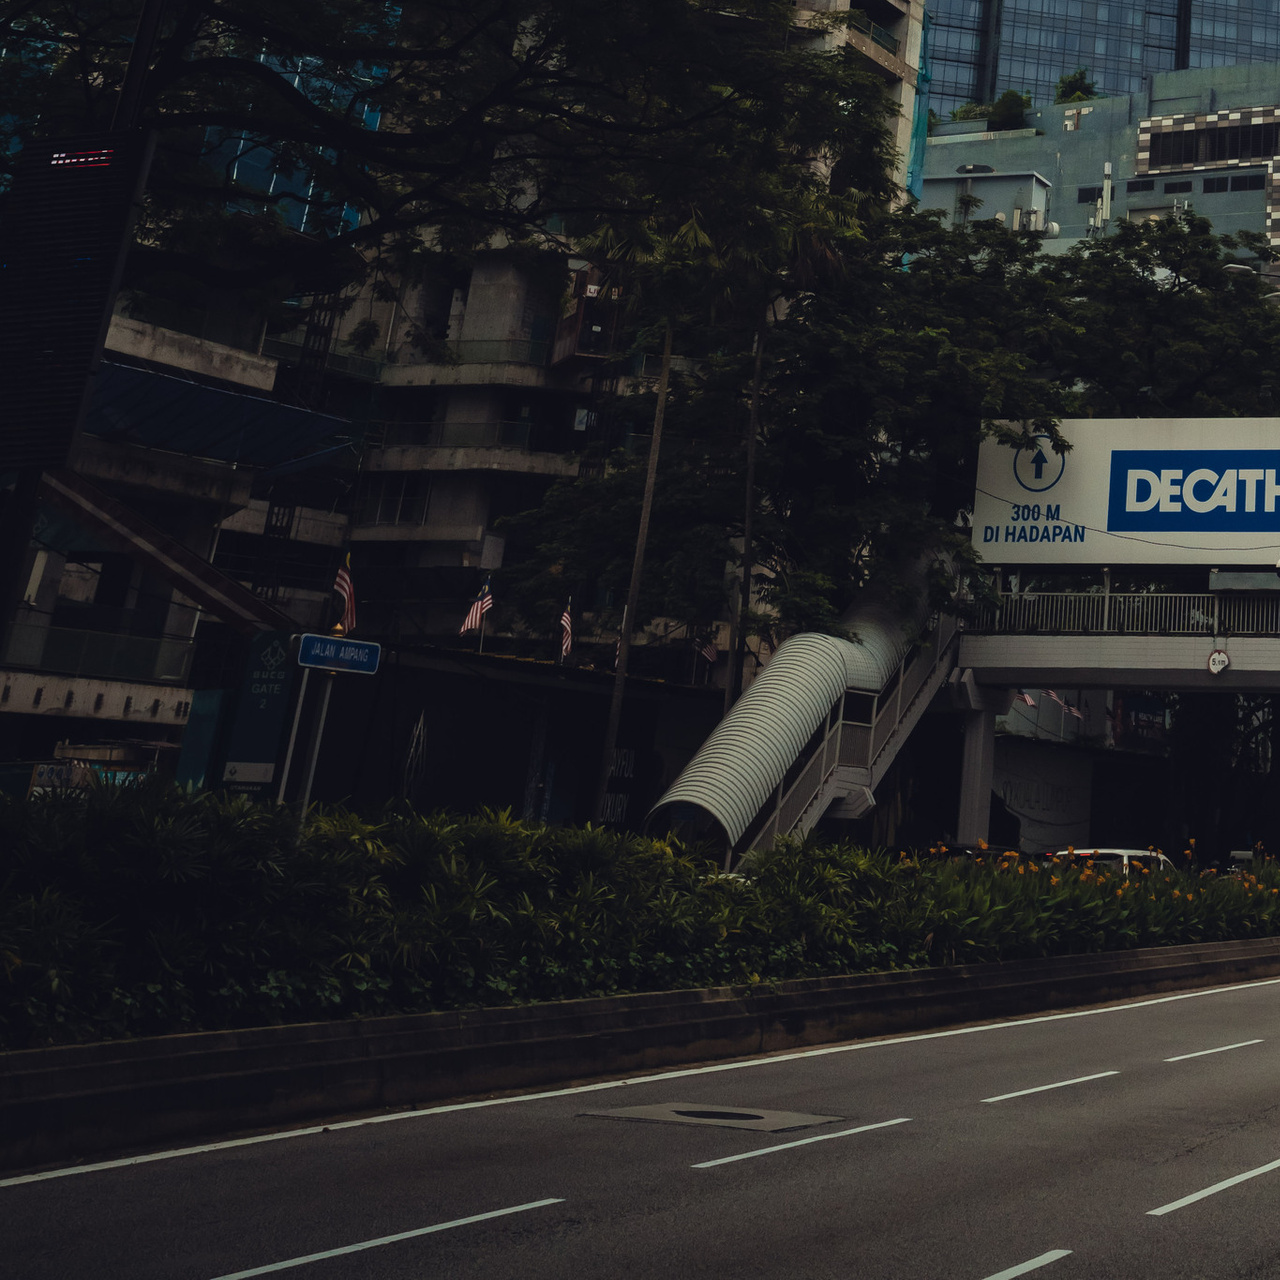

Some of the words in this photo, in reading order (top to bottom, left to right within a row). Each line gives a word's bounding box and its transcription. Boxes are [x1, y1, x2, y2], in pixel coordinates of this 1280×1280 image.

[1011, 504, 1041, 522] 300
[1046, 504, 1061, 521] M
[983, 525, 1000, 543] DI
[1004, 525, 1086, 543] HADAPAN
[311, 641, 336, 658] JALAN
[339, 646, 369, 662] AMPANG
[251, 683, 282, 694] GATE
[259, 698, 267, 709] 2
[600, 792, 629, 823] UXURY
